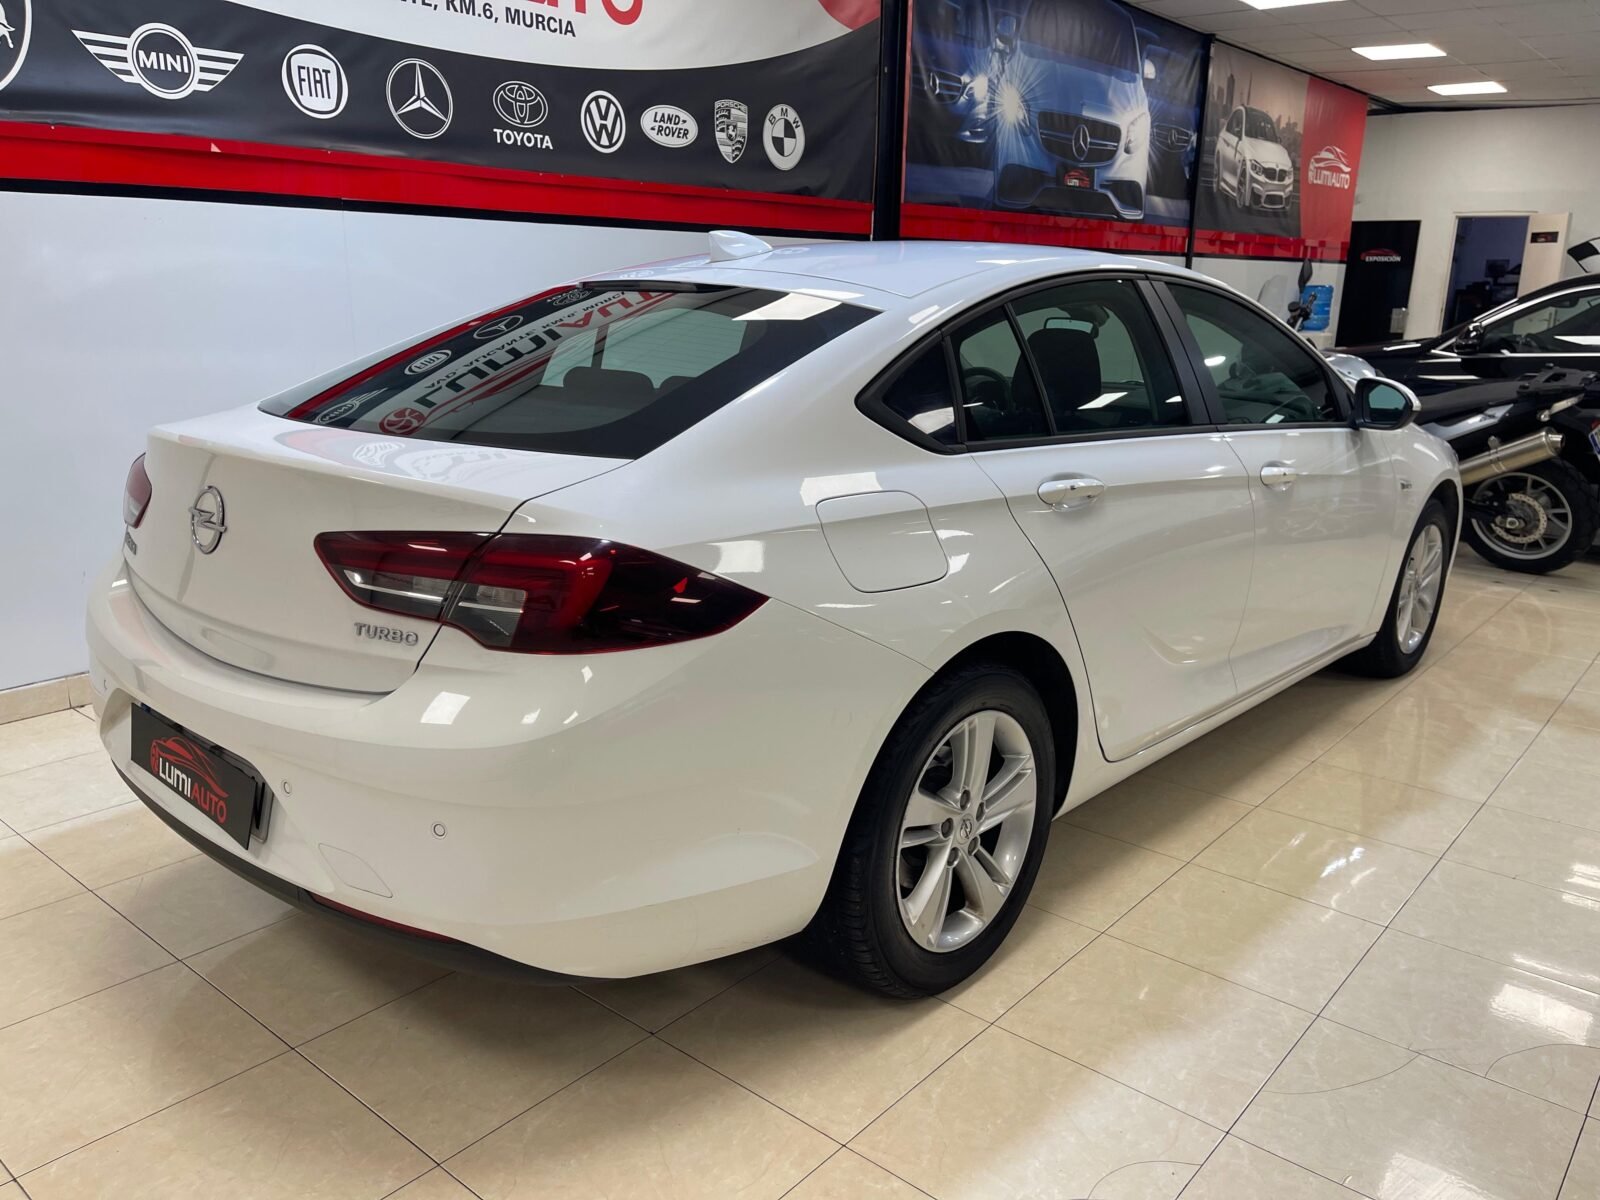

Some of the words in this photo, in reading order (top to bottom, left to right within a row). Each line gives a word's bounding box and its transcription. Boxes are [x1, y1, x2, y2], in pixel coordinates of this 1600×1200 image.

[505, 6, 577, 37] MURCIA
[138, 49, 190, 74] MINI
[297, 64, 332, 100] FIAT
[653, 111, 681, 126] LAND
[493, 128, 554, 150] TOYOTA
[656, 125, 690, 140] ROVER
[353, 621, 420, 647] TURBO
